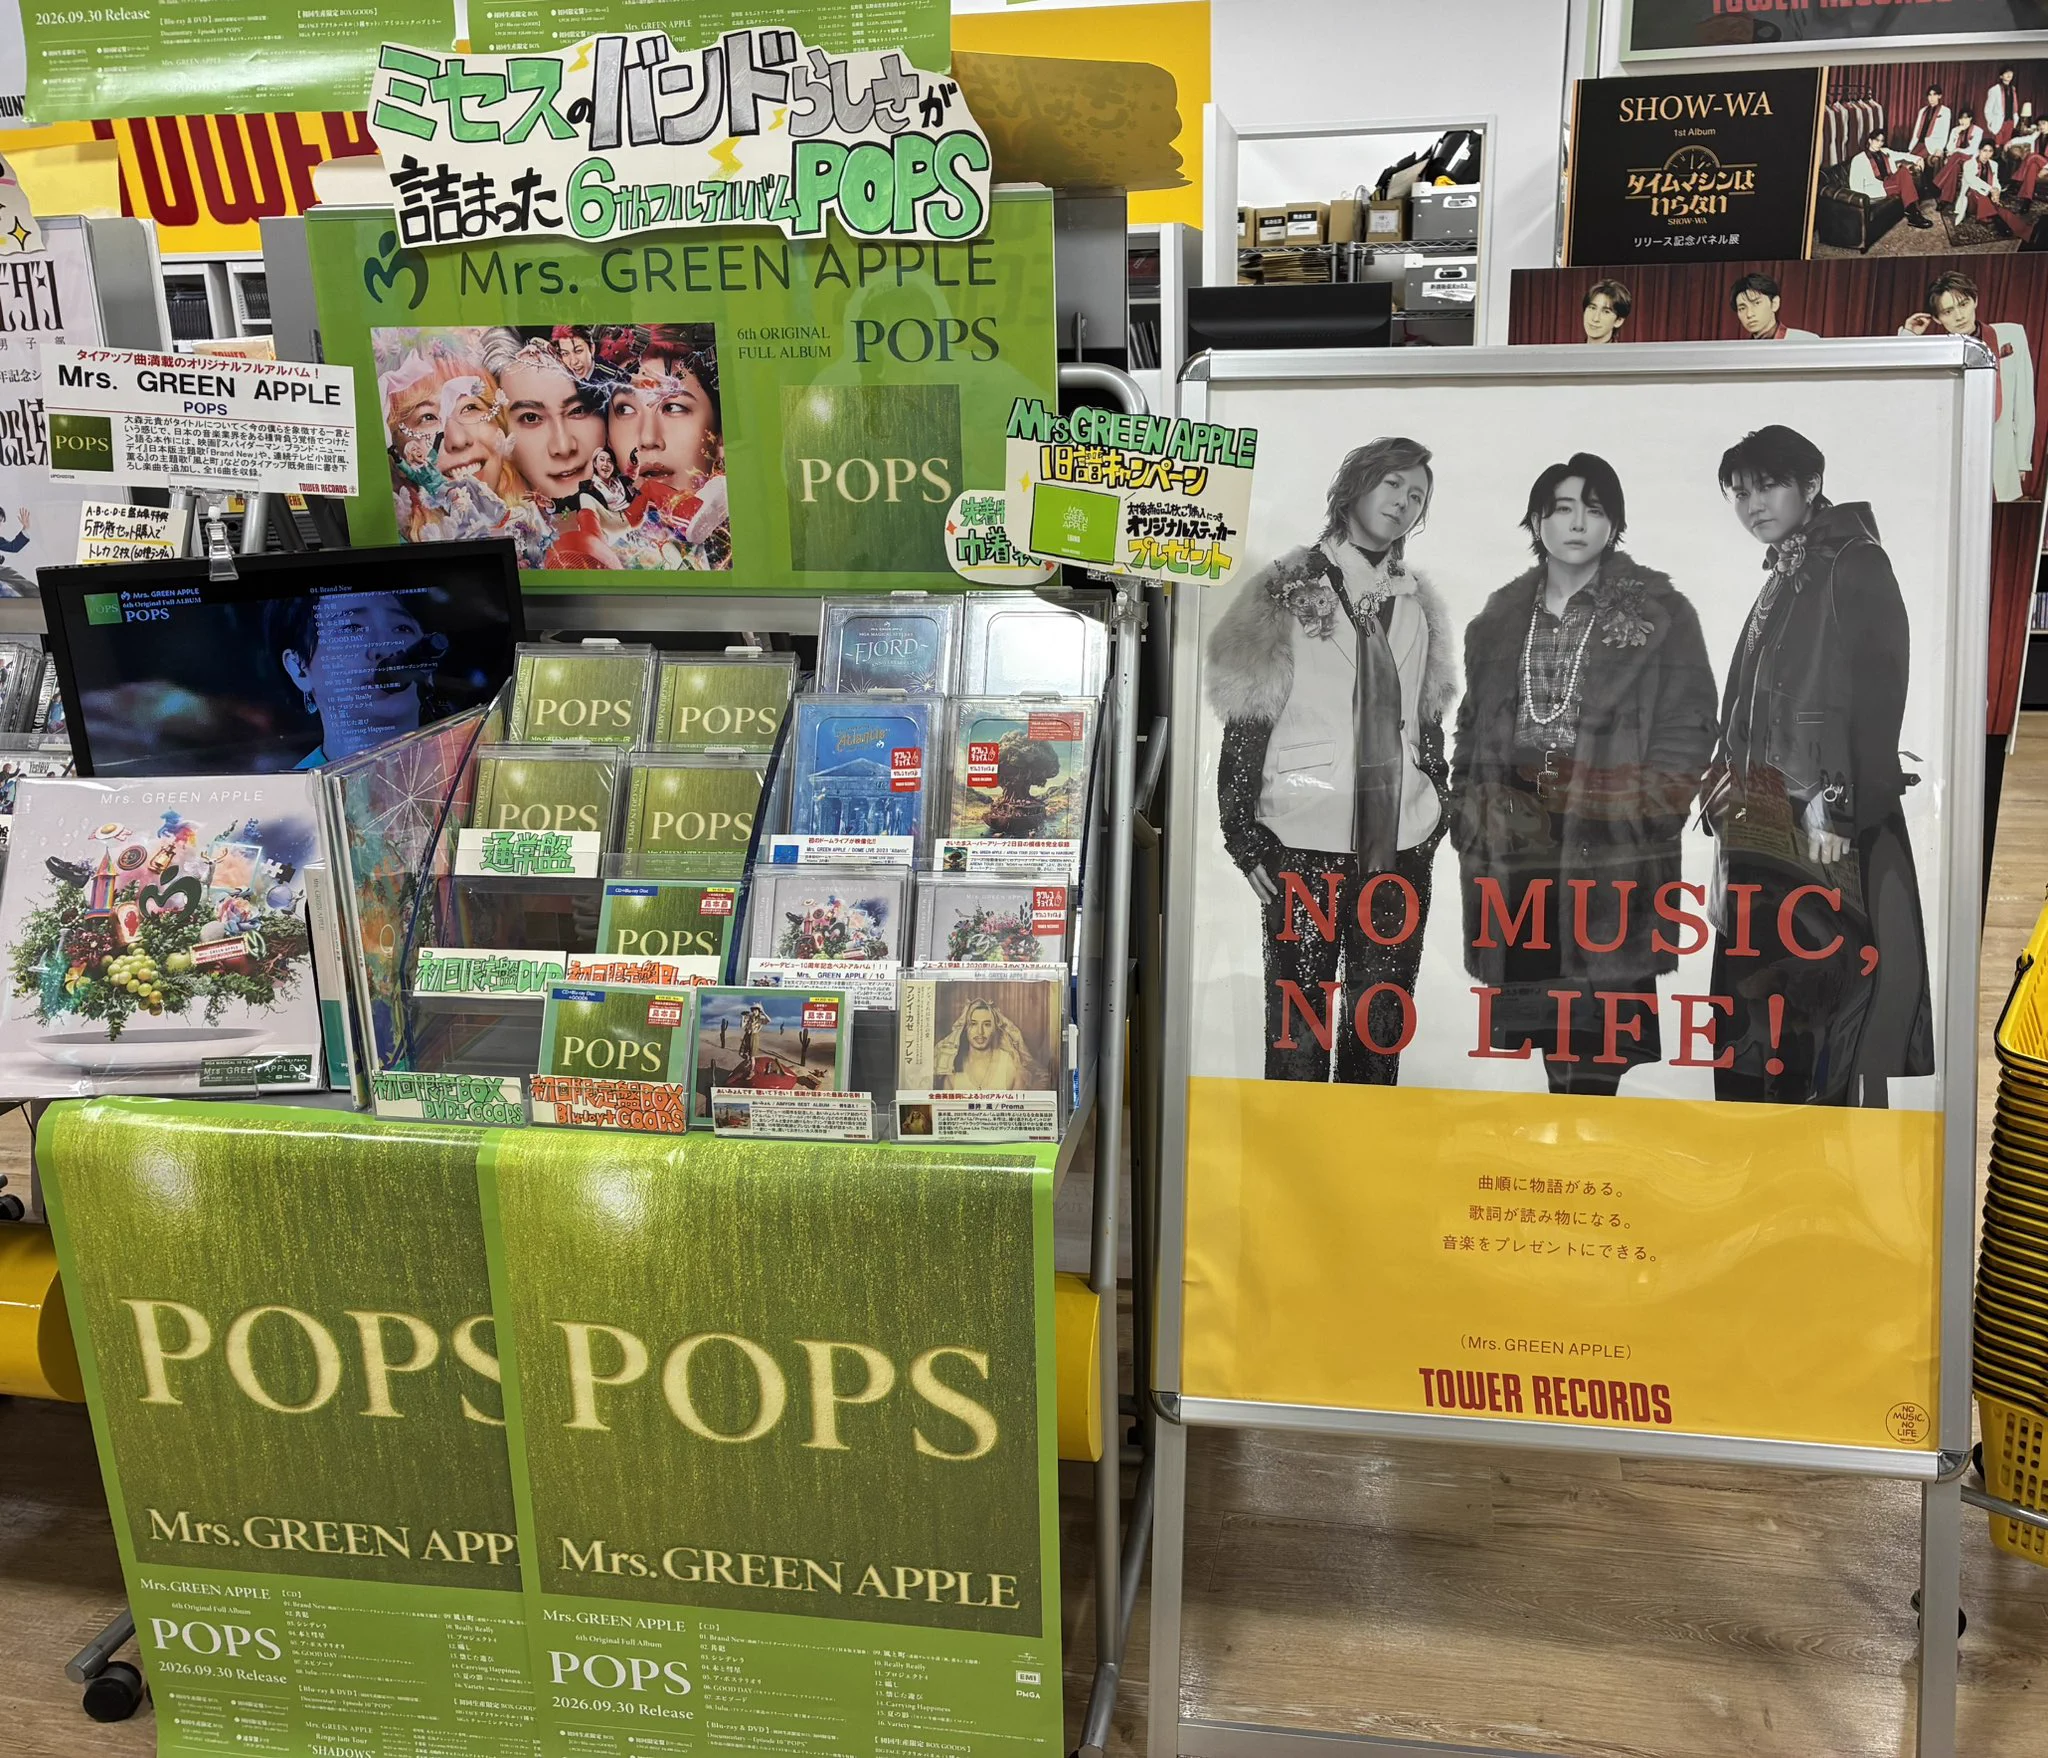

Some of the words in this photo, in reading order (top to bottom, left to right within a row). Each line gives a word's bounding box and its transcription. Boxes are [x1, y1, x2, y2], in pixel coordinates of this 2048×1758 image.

[36, 10, 102, 25] 2026.09.30
[105, 7, 150, 21] Release
[641, 21, 668, 30] GREEN
[669, 19, 692, 29] APPLE
[1618, 90, 1773, 124] SHOW-WA
[1673, 127, 1687, 137] 1st
[1688, 126, 1716, 137] Album
[791, 131, 991, 240] POPS
[1627, 171, 1755, 195] タイムマシンは
[1650, 195, 1728, 217] いらない
[1667, 217, 1708, 226] SHOW-WA
[1633, 233, 1740, 248] リリース記念パネル展
[459, 249, 579, 296] Mrs.
[599, 244, 793, 294] GREEN
[814, 238, 998, 290] APPLE
[737, 327, 757, 340] 6th
[760, 325, 831, 340] ORIGINAL
[851, 317, 1000, 363] POPS
[738, 346, 777, 360] FULL
[780, 345, 832, 359] ALBUM
[76, 349, 320, 379] タイアップ曲満載のオリジナルフルアルバム！
[58, 364, 118, 391] Mrs.
[136, 370, 236, 398] GREEN
[253, 379, 342, 406] APPLE
[183, 401, 228, 416] POPS
[55, 434, 109, 452] POPS
[1168, 418, 1258, 470] APPLE
[299, 483, 319, 492] TOWER
[321, 484, 348, 494] RECORDS
[799, 457, 952, 503] POPS
[1126, 515, 1237, 542] オリジナルステッカー
[1127, 536, 1233, 579] プレゼント
[151, 590, 175, 598] GREEN
[339, 584, 352, 592] New
[134, 600, 161, 609] Original
[176, 597, 202, 605] ALBUM
[125, 608, 170, 623] POPS
[533, 698, 632, 727] POPS
[679, 705, 777, 735] POPS
[142, 791, 201, 804] GREEN
[209, 790, 264, 803] APPLE
[500, 803, 599, 831] POPS
[650, 810, 752, 842] POPS
[480, 831, 575, 875] 通常盤
[1036, 892, 1054, 900] タワレコ
[1275, 872, 1420, 946] NO
[1471, 876, 1880, 978] MUSIC,
[617, 929, 714, 956] POPS
[652, 1009, 677, 1018] 見本品
[807, 1012, 833, 1020] 見本品
[1274, 978, 1418, 1055] NO
[1468, 986, 1785, 1076] LIFE!
[560, 1036, 662, 1073] POPS
[203, 1067, 224, 1076] Mrs.
[264, 1064, 294, 1073] APPLE
[1478, 1174, 1623, 1198] 曲順に物語がある。
[1468, 1204, 1632, 1230] 歌詞が読み物になる。
[1442, 1234, 1657, 1262] 音楽をプレゼントにできる。
[1504, 1338, 1564, 1355] GREEN
[120, 1297, 506, 1427] POPS
[552, 1320, 999, 1461] POPS
[1418, 1367, 1524, 1414] TOWER
[1531, 1375, 1673, 1425] RECORDS
[1902, 1405, 1915, 1413] NO
[420, 1529, 521, 1568] APP
[224, 1586, 272, 1600] APPLE
[852, 1563, 1021, 1611] APPLE
[184, 1603, 212, 1613] Original
[213, 1605, 227, 1613] Full
[228, 1607, 251, 1615] Album
[635, 1617, 686, 1633] APPLE
[148, 1617, 282, 1662] POPS
[589, 1635, 620, 1645] Original
[621, 1638, 635, 1646] Full
[637, 1640, 662, 1649] Album
[709, 1634, 730, 1643] Brand
[731, 1635, 745, 1644] New
[158, 1660, 234, 1679] 2026.09.30
[235, 1669, 288, 1685] Release
[489, 1666, 521, 1675] Happiness
[547, 1650, 692, 1695] POPS
[883, 1660, 904, 1670] Really
[906, 1662, 926, 1671] Really
[1019, 1673, 1037, 1682] EMI
[713, 1685, 737, 1693] GOOD
[737, 1686, 752, 1694] DAY
[552, 1696, 635, 1714] 2026.09.30
[638, 1704, 694, 1720] Release
[886, 1700, 916, 1711] Carrying
[917, 1703, 951, 1713] Happiness
[322, 1723, 348, 1731] GREEN
[350, 1724, 374, 1734] APPLE
[887, 1721, 911, 1730] Variety
[351, 1736, 368, 1744] Tour
[707, 1731, 746, 1742] Documentary
[925, 1741, 940, 1749] BOX
